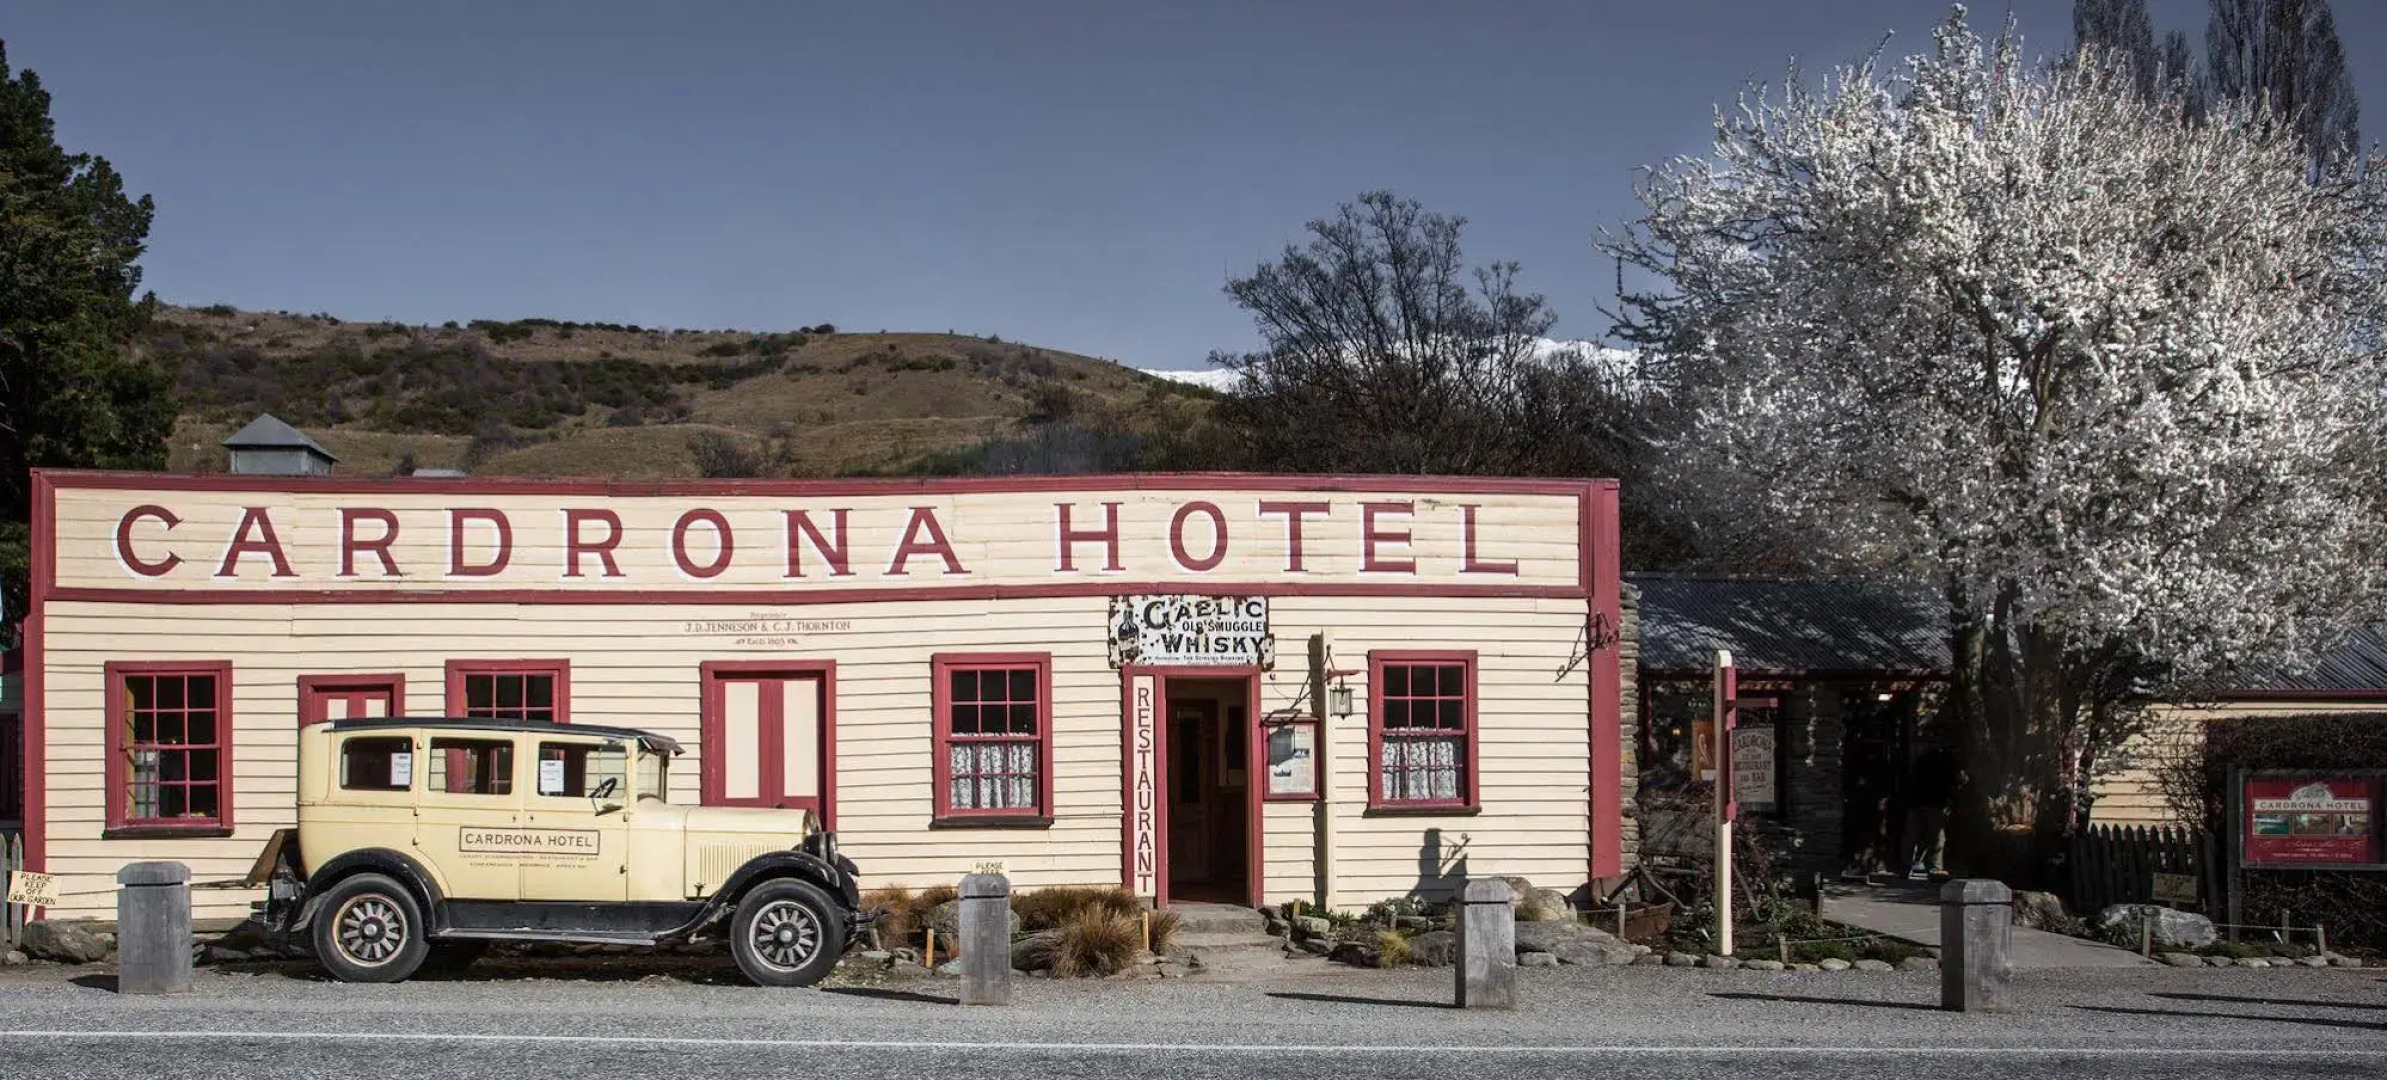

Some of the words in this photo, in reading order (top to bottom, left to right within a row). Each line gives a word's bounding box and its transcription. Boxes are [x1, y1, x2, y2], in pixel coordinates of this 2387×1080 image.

[114, 504, 972, 578] CARDRONA
[1052, 498, 1519, 577] HOTEL
[1143, 600, 1263, 629] GAELIC
[1160, 633, 1265, 653] WHISKY
[1136, 687, 1152, 892] RESTAURANT
[2326, 802, 2364, 810] HOTEL
[465, 833, 542, 845] CARDRONA
[547, 836, 593, 847] HOTEL
[20, 873, 52, 882] PLEASE
[25, 881, 47, 889] KEEP
